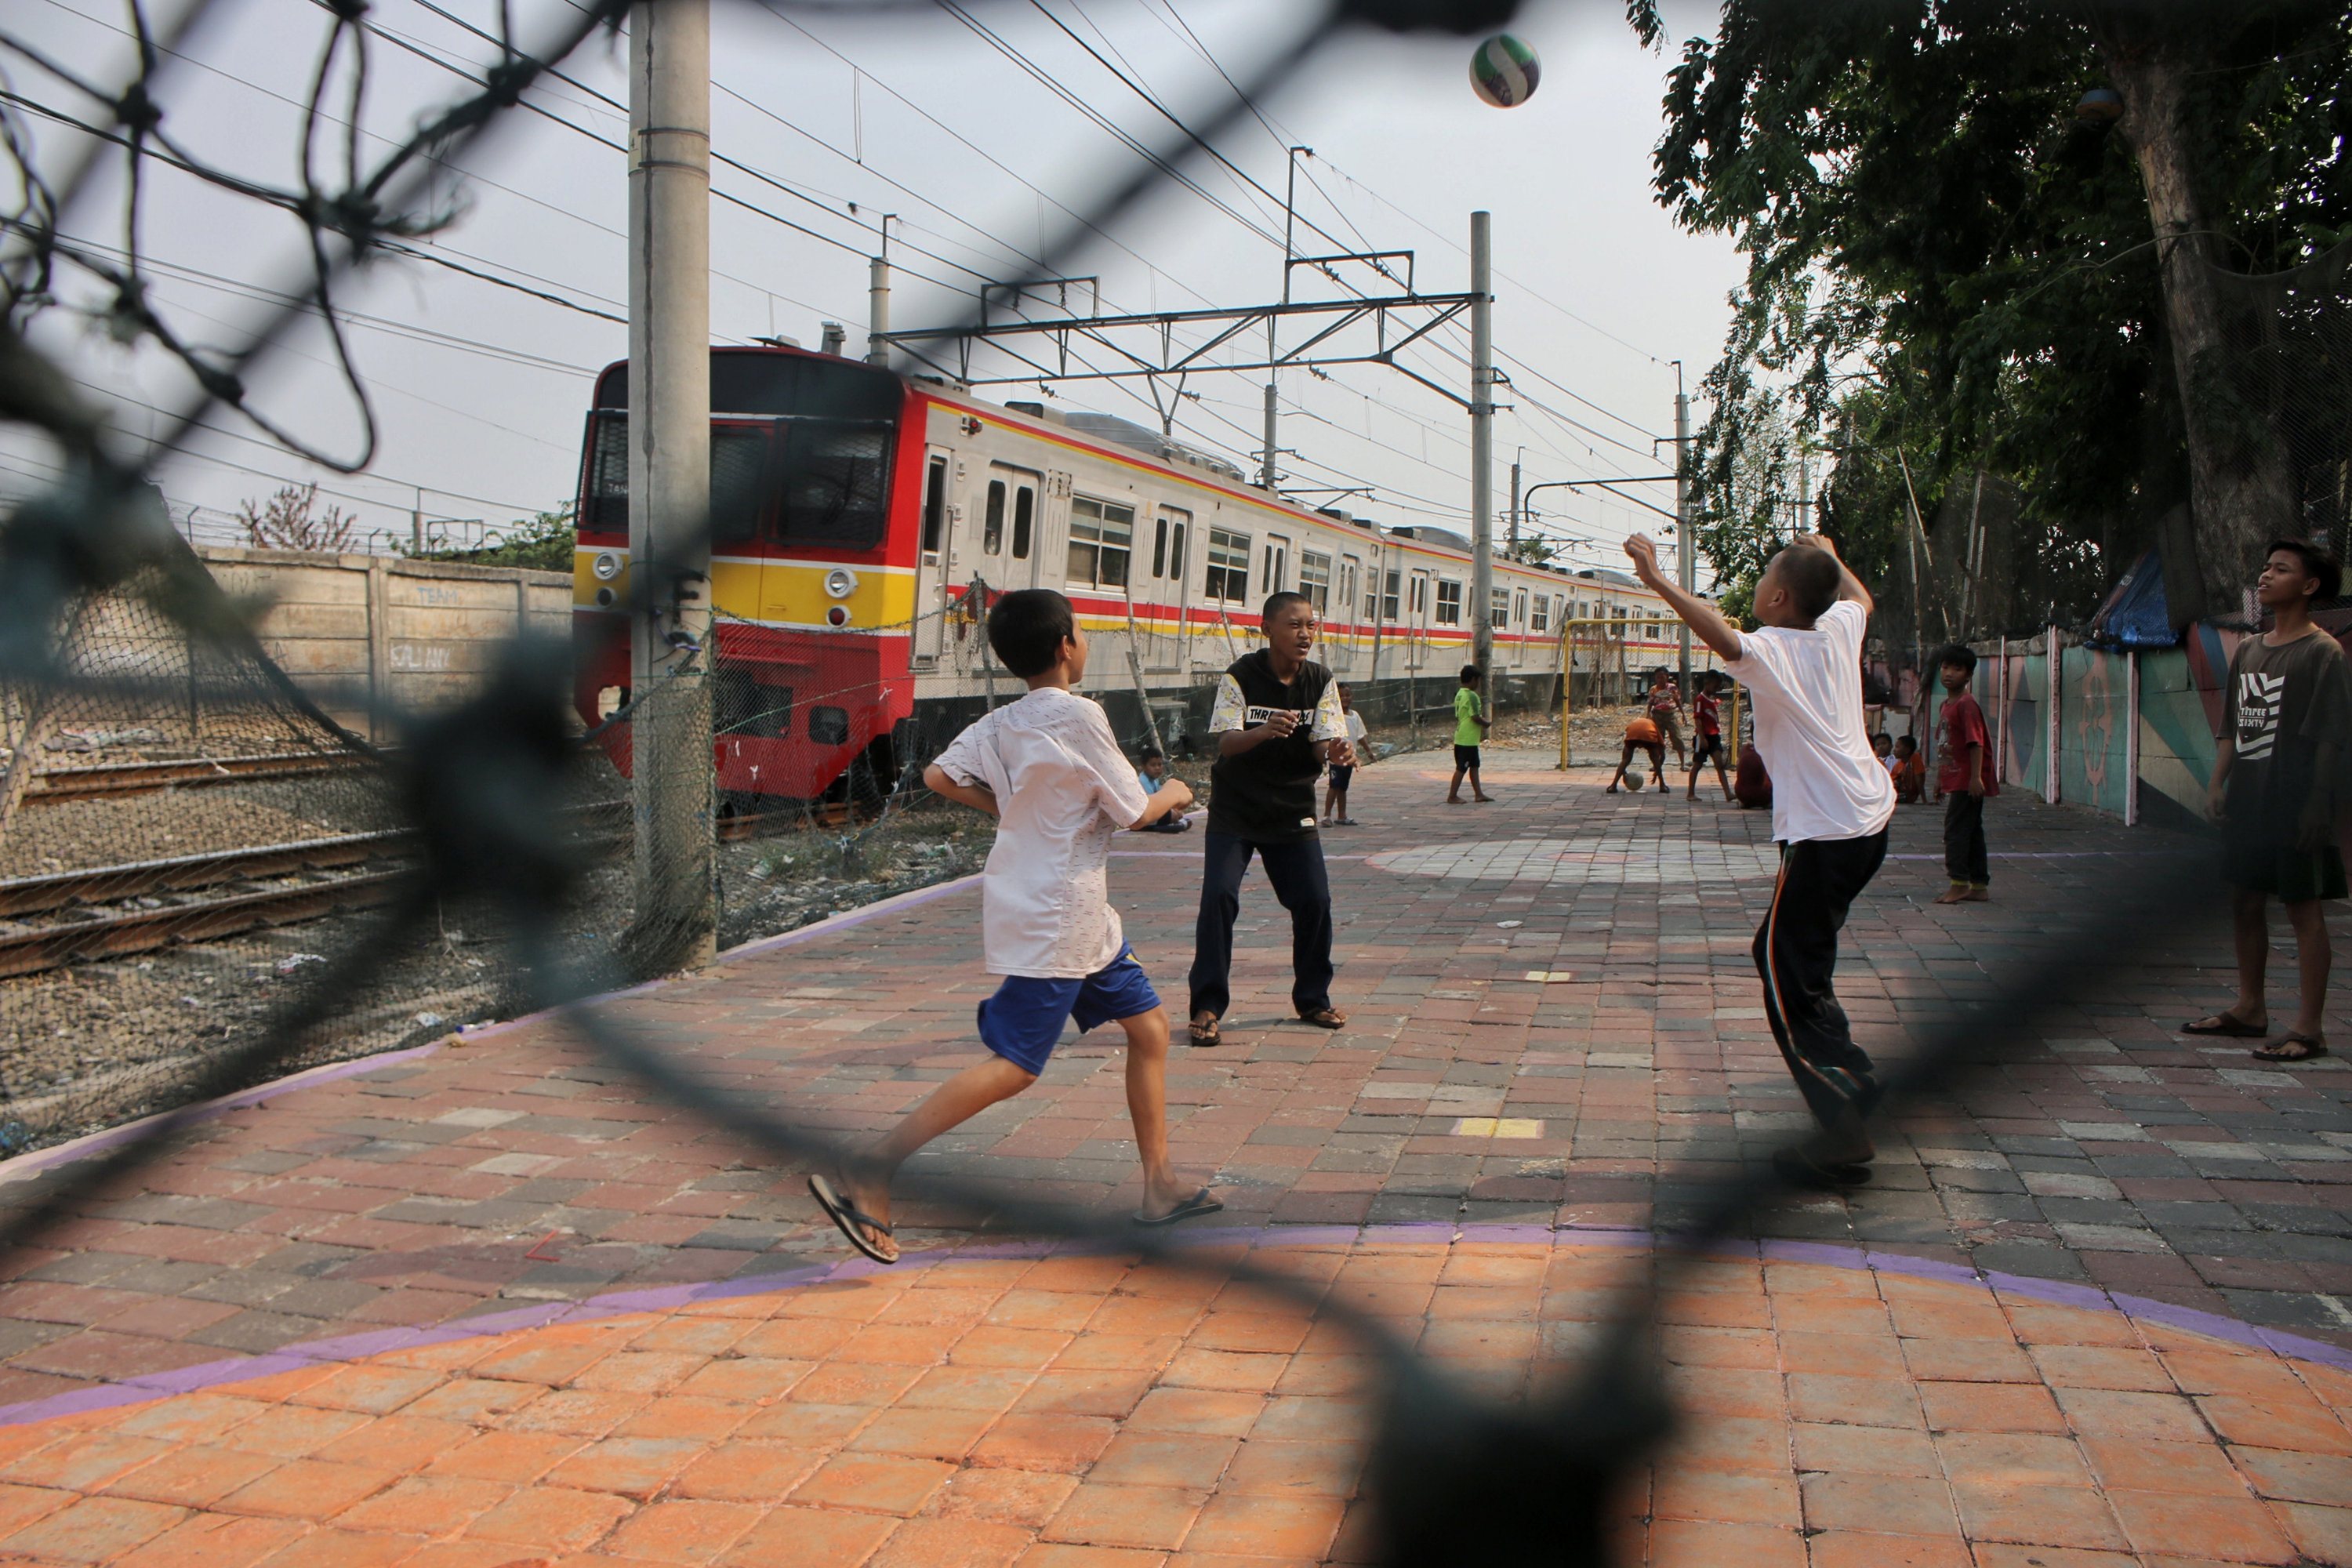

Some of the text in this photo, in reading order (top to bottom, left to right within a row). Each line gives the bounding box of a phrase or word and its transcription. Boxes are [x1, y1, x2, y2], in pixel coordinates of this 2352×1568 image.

[417, 586, 458, 605] TEAM
[1250, 709, 1276, 721] THR
[2239, 718, 2264, 728] SIXTY
